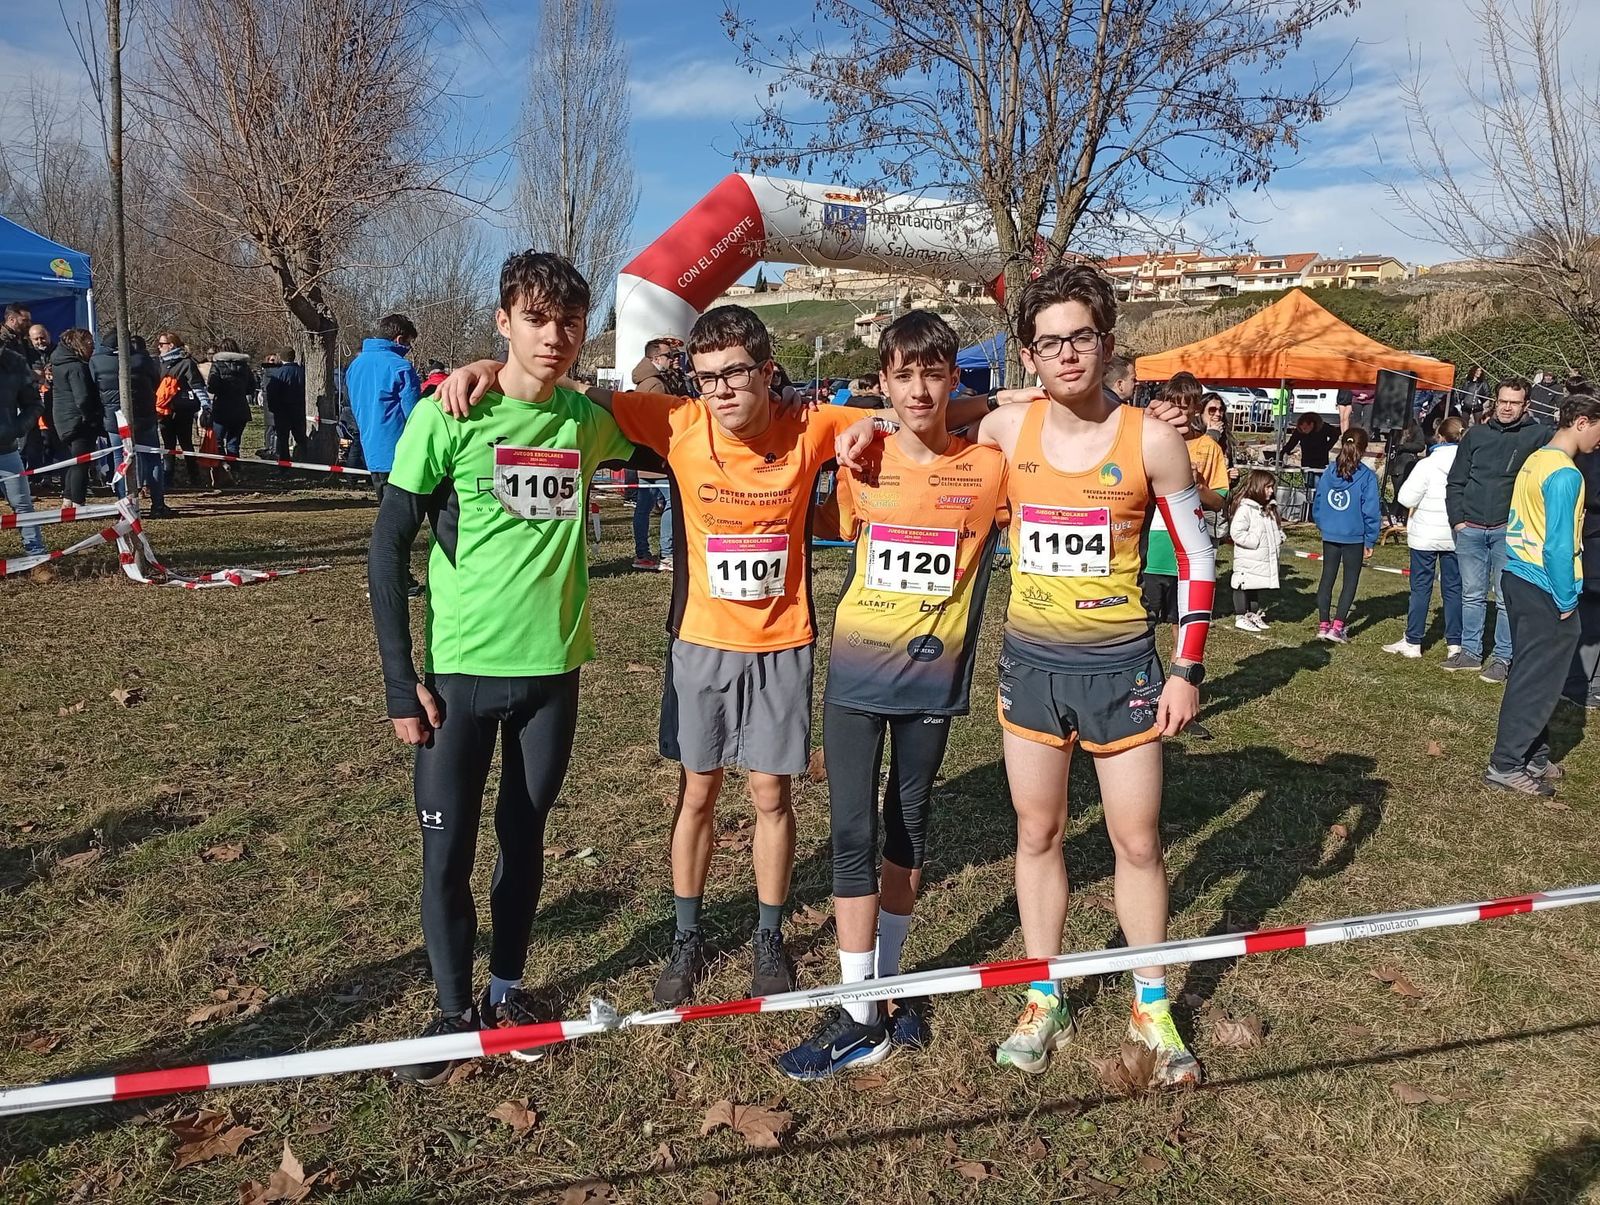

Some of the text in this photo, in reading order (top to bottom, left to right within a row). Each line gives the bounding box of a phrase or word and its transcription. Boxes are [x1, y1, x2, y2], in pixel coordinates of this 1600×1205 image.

[871, 208, 952, 231] Diputación
[677, 215, 755, 289] CON EL DEPORTE
[866, 242, 963, 263] de Salamanca
[1018, 461, 1040, 473] EKT
[503, 474, 575, 499] 1105
[720, 488, 792, 499] ESTER RODRÍGUEZ
[719, 496, 792, 507] CLÍNICA DENTAL
[1056, 510, 1088, 518] ECOLARES
[716, 518, 743, 526] CERVISAN
[888, 528, 908, 536] JUEGOS
[1029, 530, 1106, 556] 1104
[878, 549, 951, 576] 1120
[717, 558, 781, 581] 1101
[857, 599, 897, 610] ALTAFIT
[863, 638, 891, 650] CERVISAN
[841, 986, 905, 1001] Diputación
